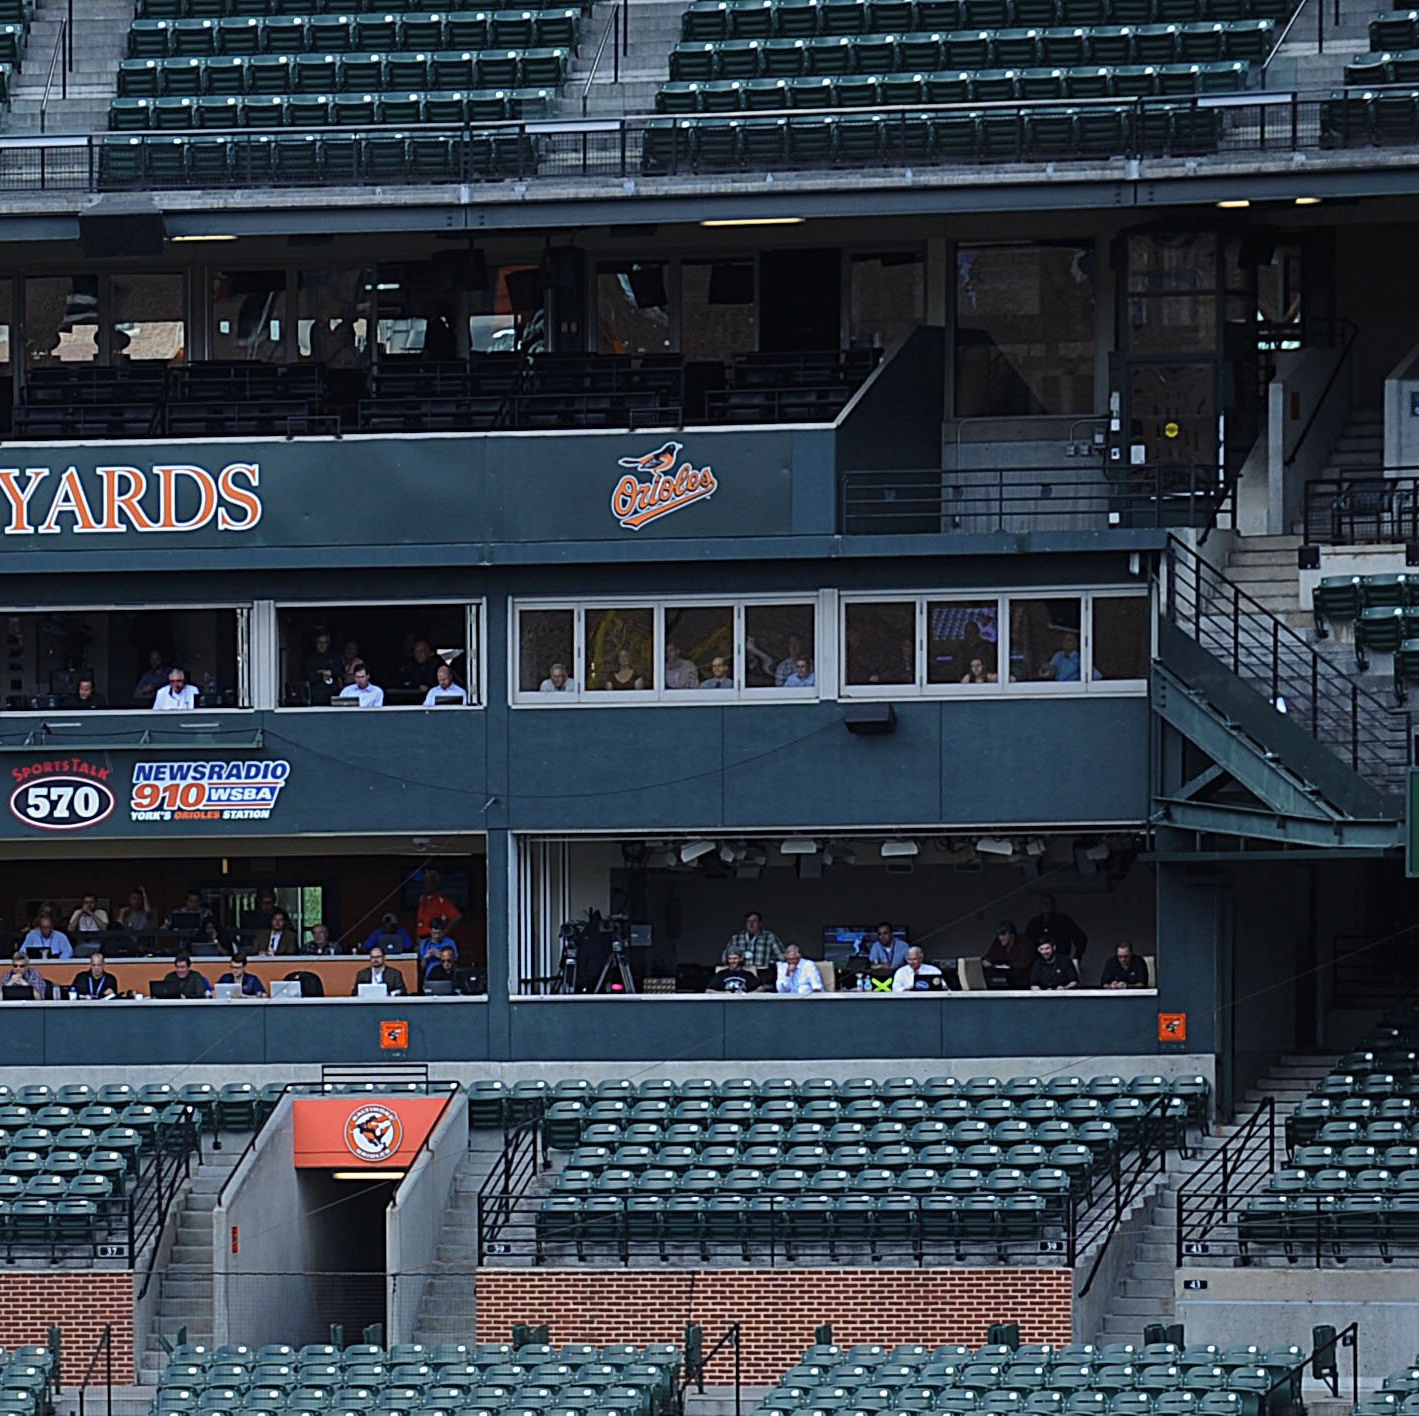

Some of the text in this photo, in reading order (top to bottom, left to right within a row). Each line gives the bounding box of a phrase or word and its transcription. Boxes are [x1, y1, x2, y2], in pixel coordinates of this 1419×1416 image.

[611, 463, 718, 526] Orioles
[134, 761, 289, 782] NEWSRADIO
[27, 786, 100, 818] 570
[132, 782, 272, 810] 910 WSBA
[131, 809, 270, 821] YORK'S ORIOLES STATION
